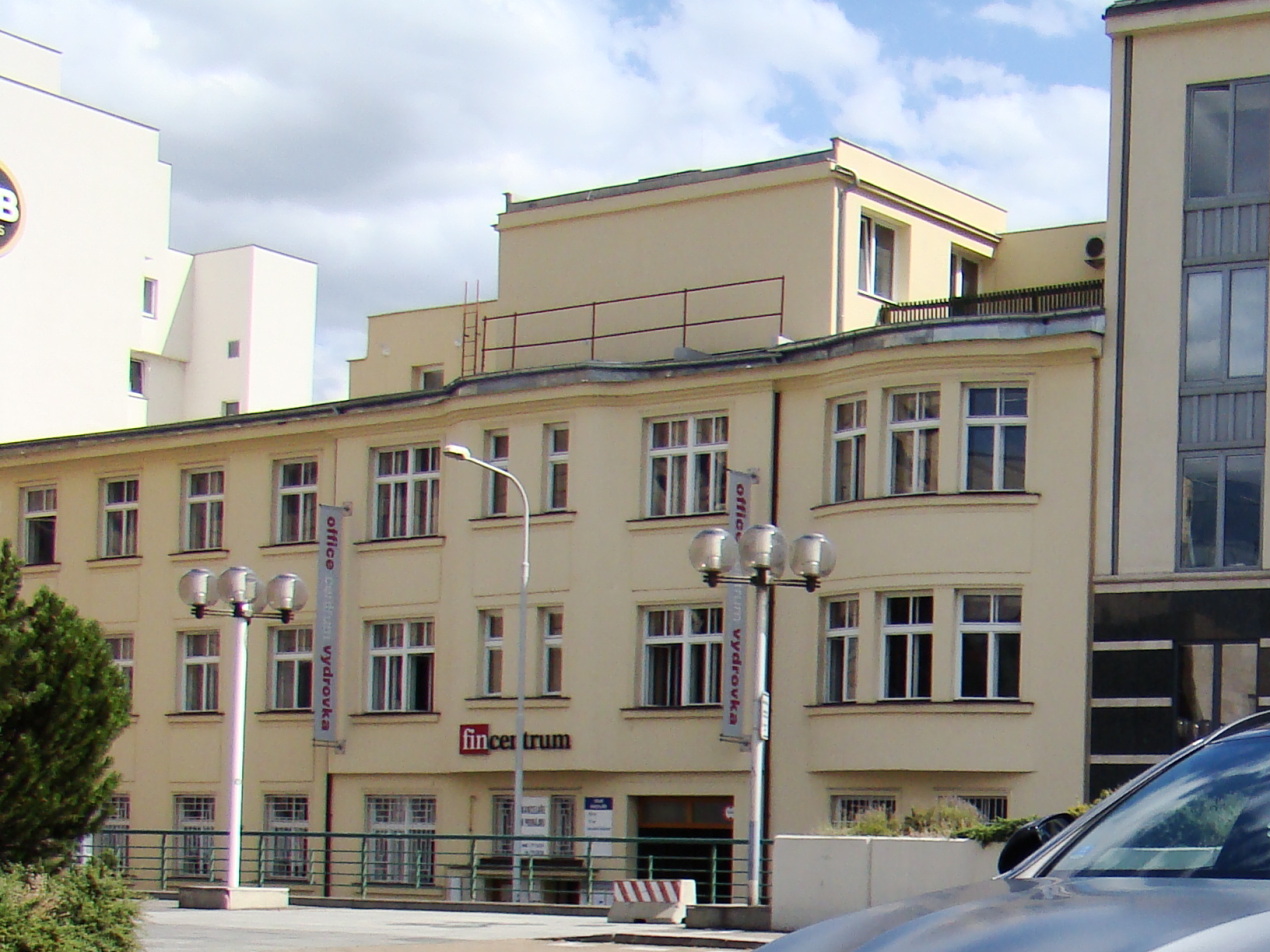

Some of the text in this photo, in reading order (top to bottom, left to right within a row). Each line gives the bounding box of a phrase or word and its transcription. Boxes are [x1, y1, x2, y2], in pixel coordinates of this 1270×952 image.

[326, 516, 338, 570] office
[321, 645, 334, 731] vydrovka
[728, 629, 742, 725] vydrovka
